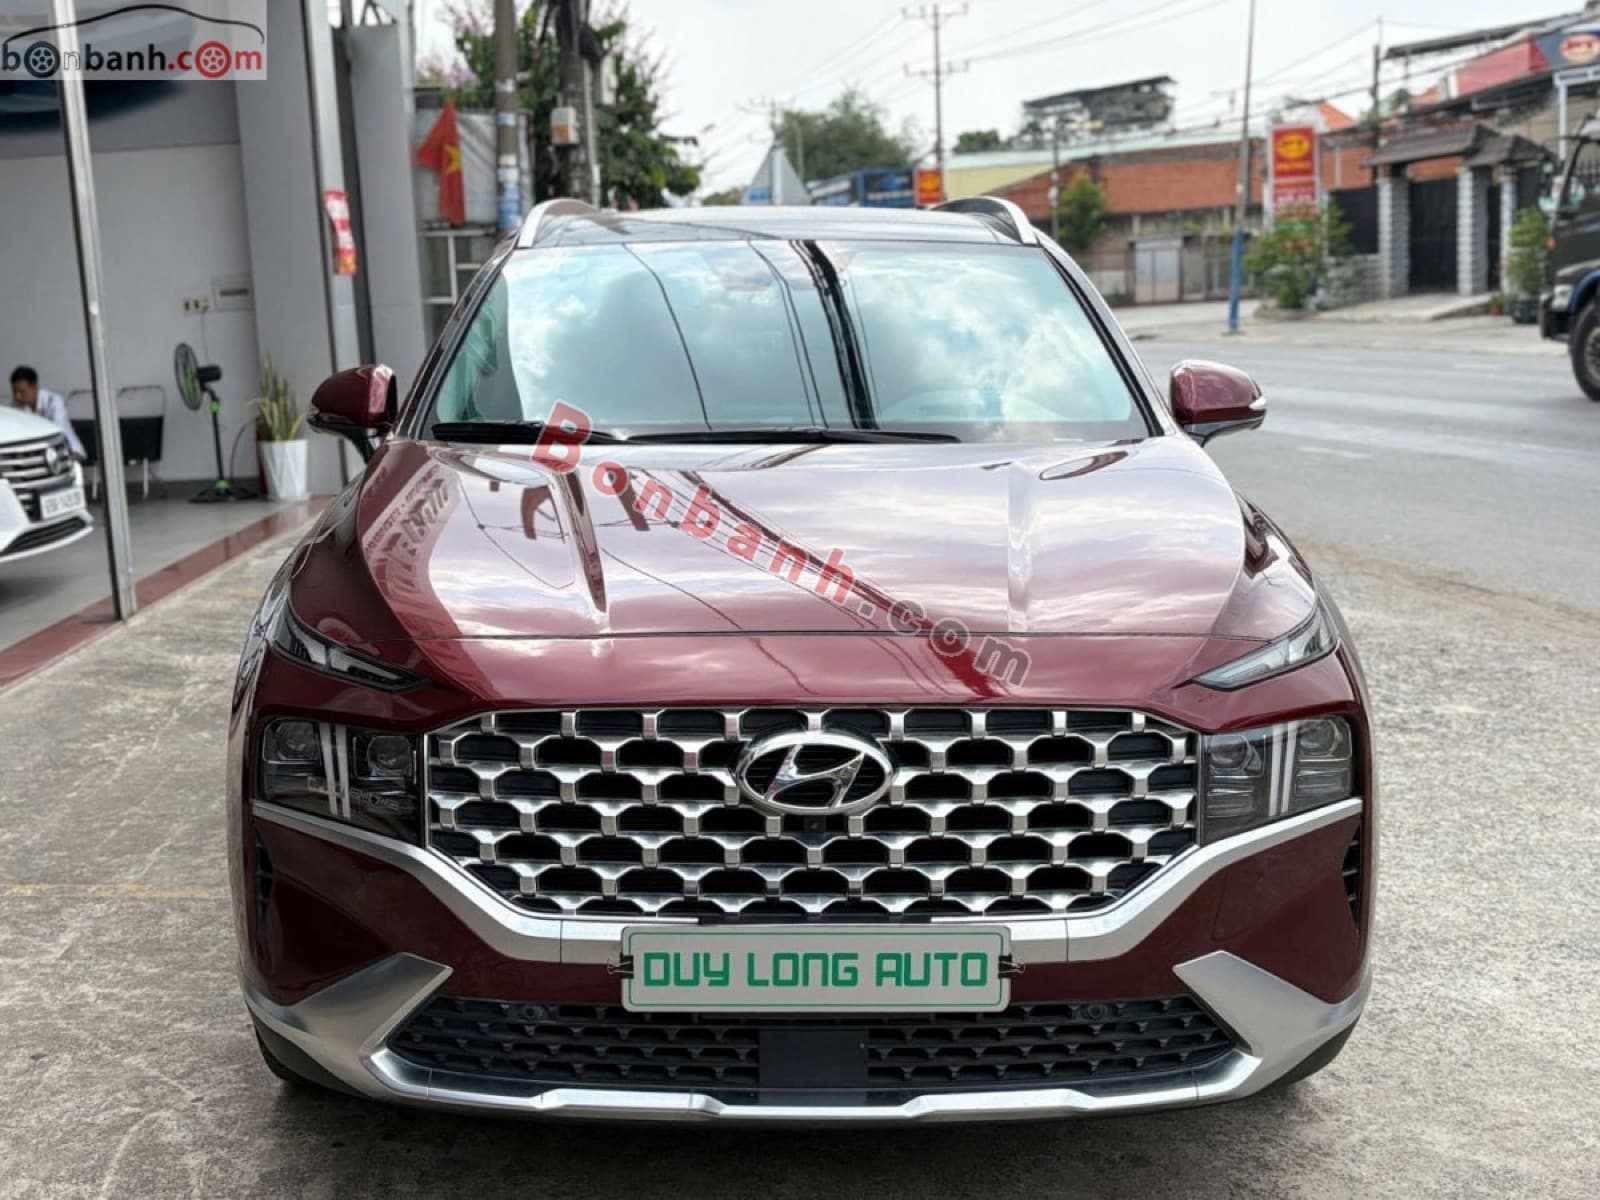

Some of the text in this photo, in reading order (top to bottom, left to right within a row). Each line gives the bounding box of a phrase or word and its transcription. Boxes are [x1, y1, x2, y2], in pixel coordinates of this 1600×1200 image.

[643, 952, 989, 987] DUY LONG AUTO
